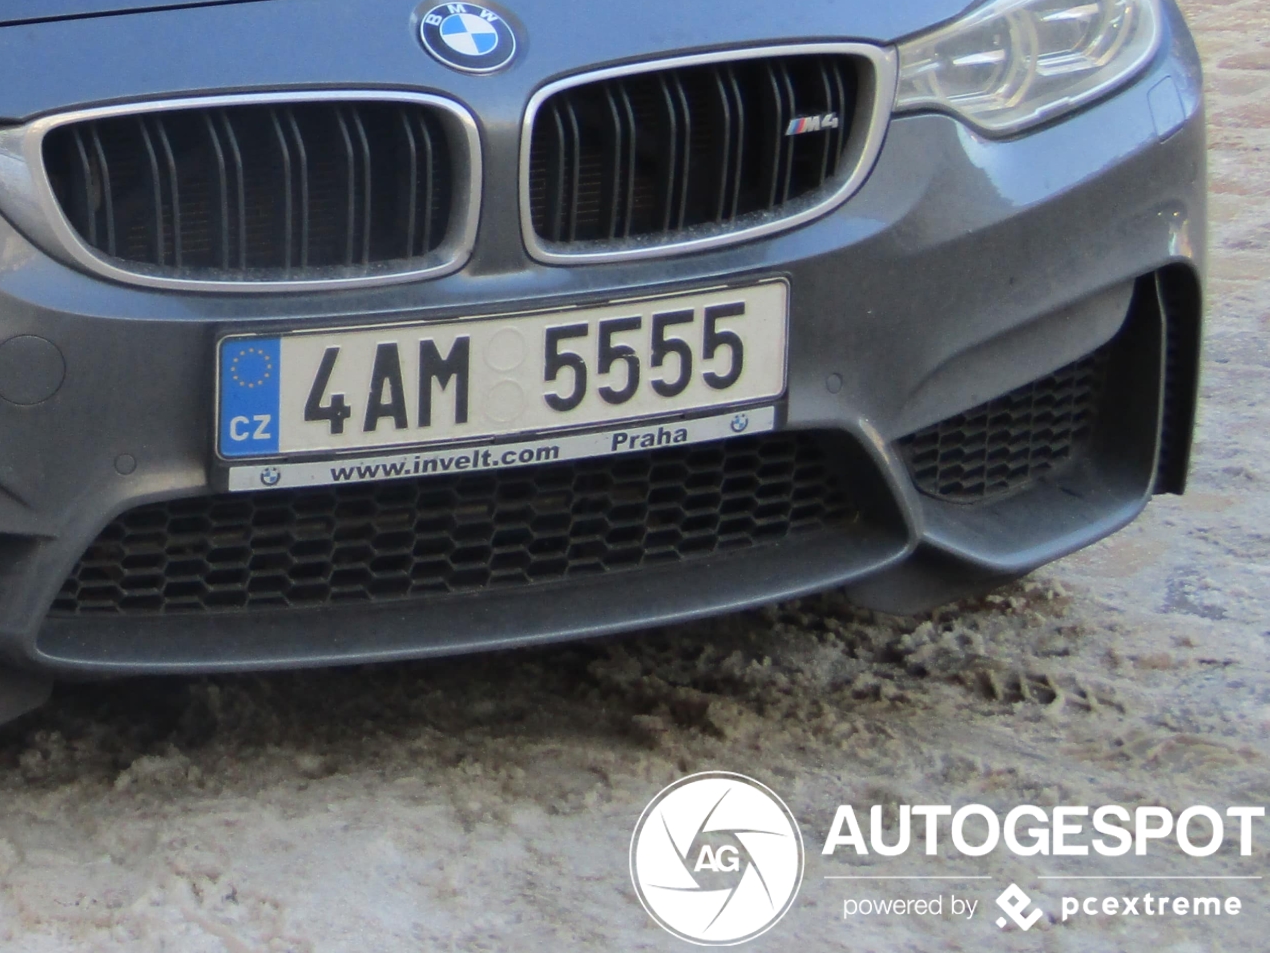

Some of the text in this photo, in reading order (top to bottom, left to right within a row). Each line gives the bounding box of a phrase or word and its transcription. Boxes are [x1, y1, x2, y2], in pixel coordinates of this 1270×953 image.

[425, 3, 498, 26] BMW
[804, 113, 838, 132] M4
[230, 301, 745, 442] CZ 4AM 5555
[329, 426, 688, 483] www.invelt.com Praha
